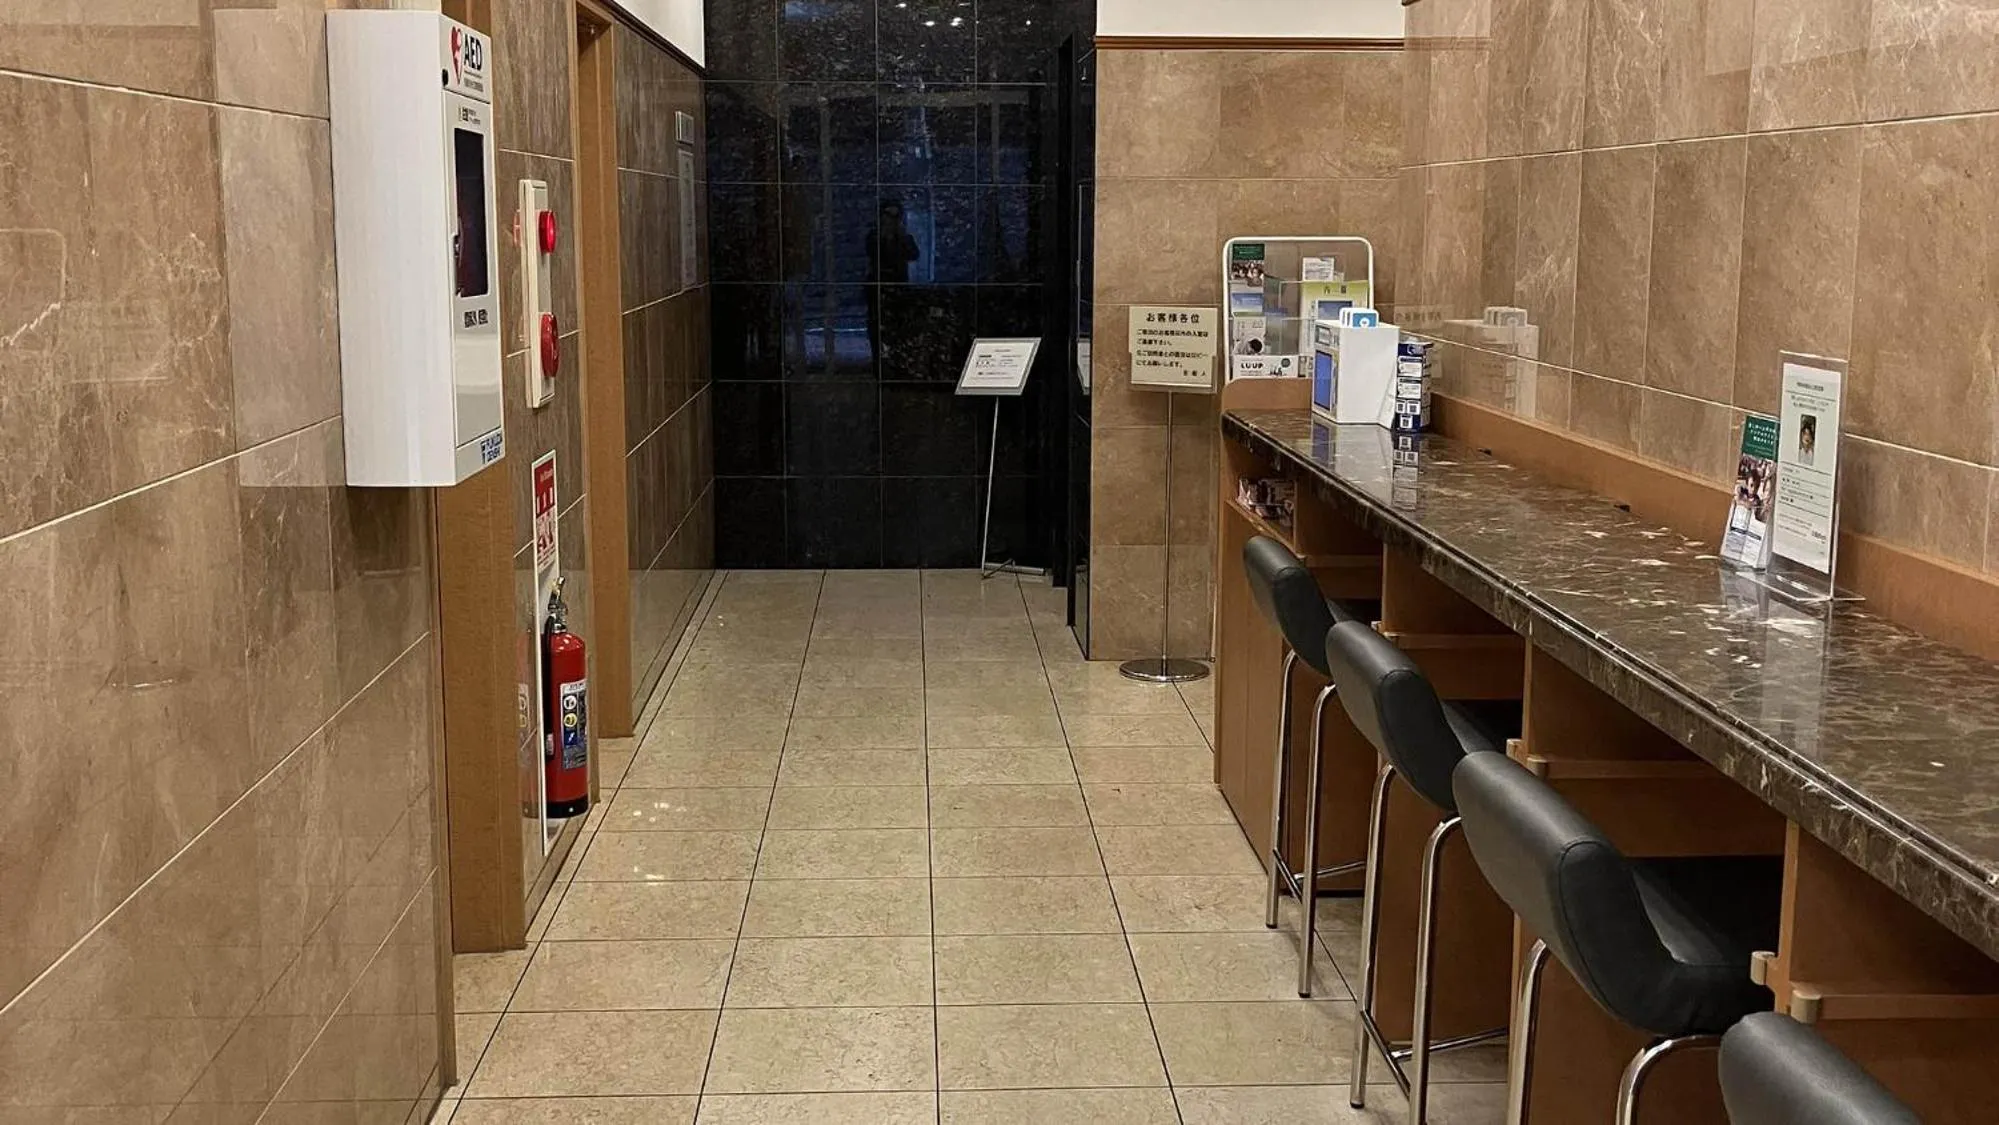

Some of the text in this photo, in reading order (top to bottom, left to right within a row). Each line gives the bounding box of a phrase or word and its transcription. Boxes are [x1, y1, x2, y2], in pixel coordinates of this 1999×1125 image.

[464, 33, 483, 71] AED
[1146, 312, 1200, 323] お客様各位
